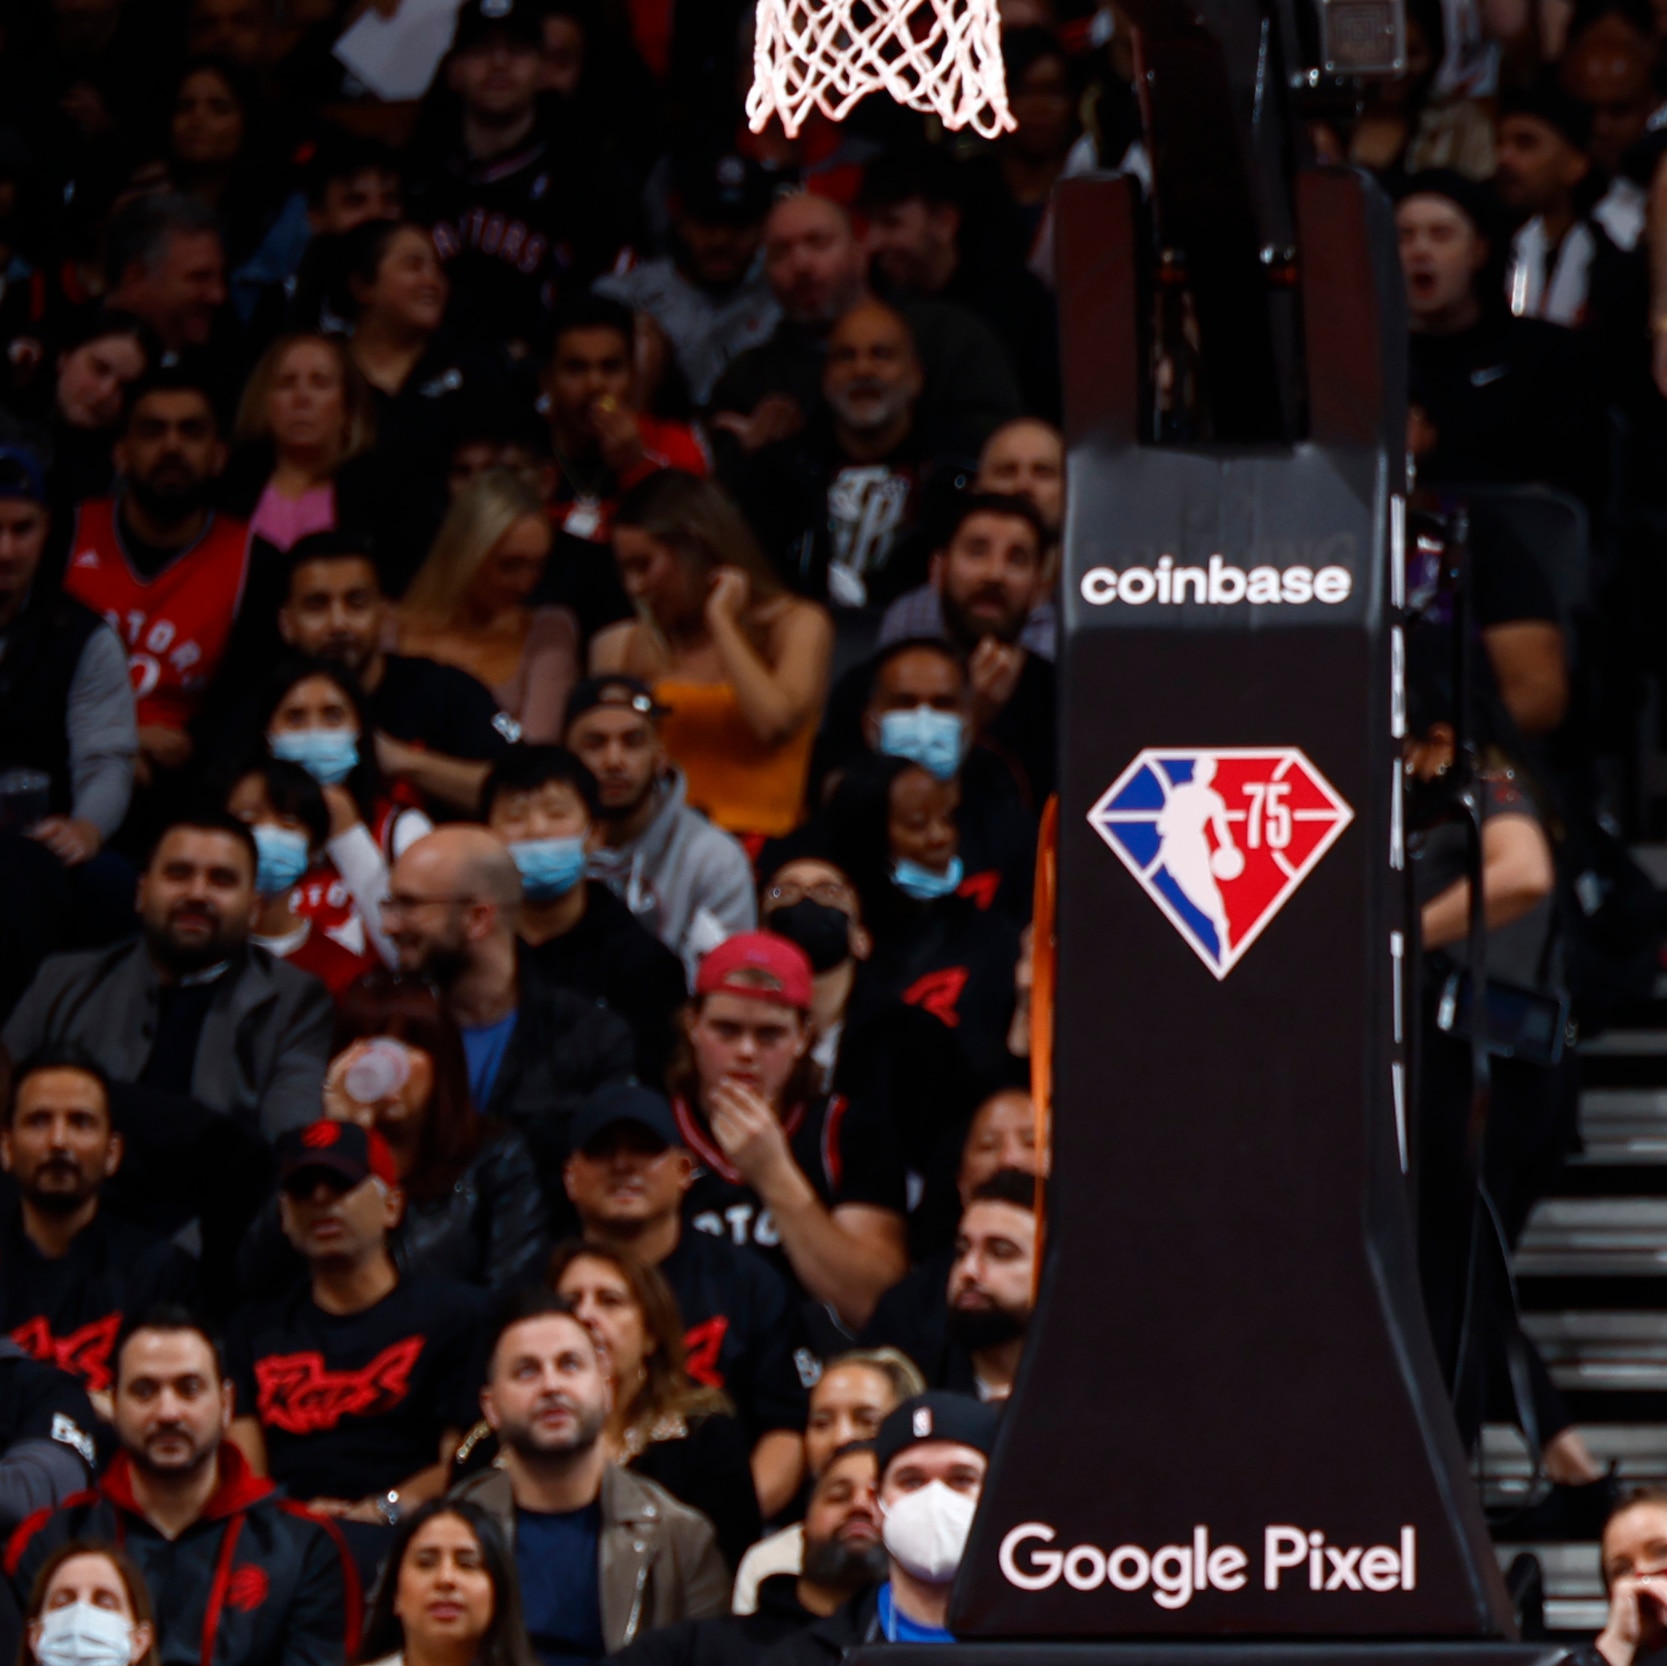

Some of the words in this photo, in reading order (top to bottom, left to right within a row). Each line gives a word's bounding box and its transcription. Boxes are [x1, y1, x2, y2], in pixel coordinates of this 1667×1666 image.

[1081, 555, 1352, 604] coinbase
[1242, 782, 1292, 848] 75
[998, 1521, 1248, 1610] Google
[1264, 1524, 1417, 1592] Pixel
